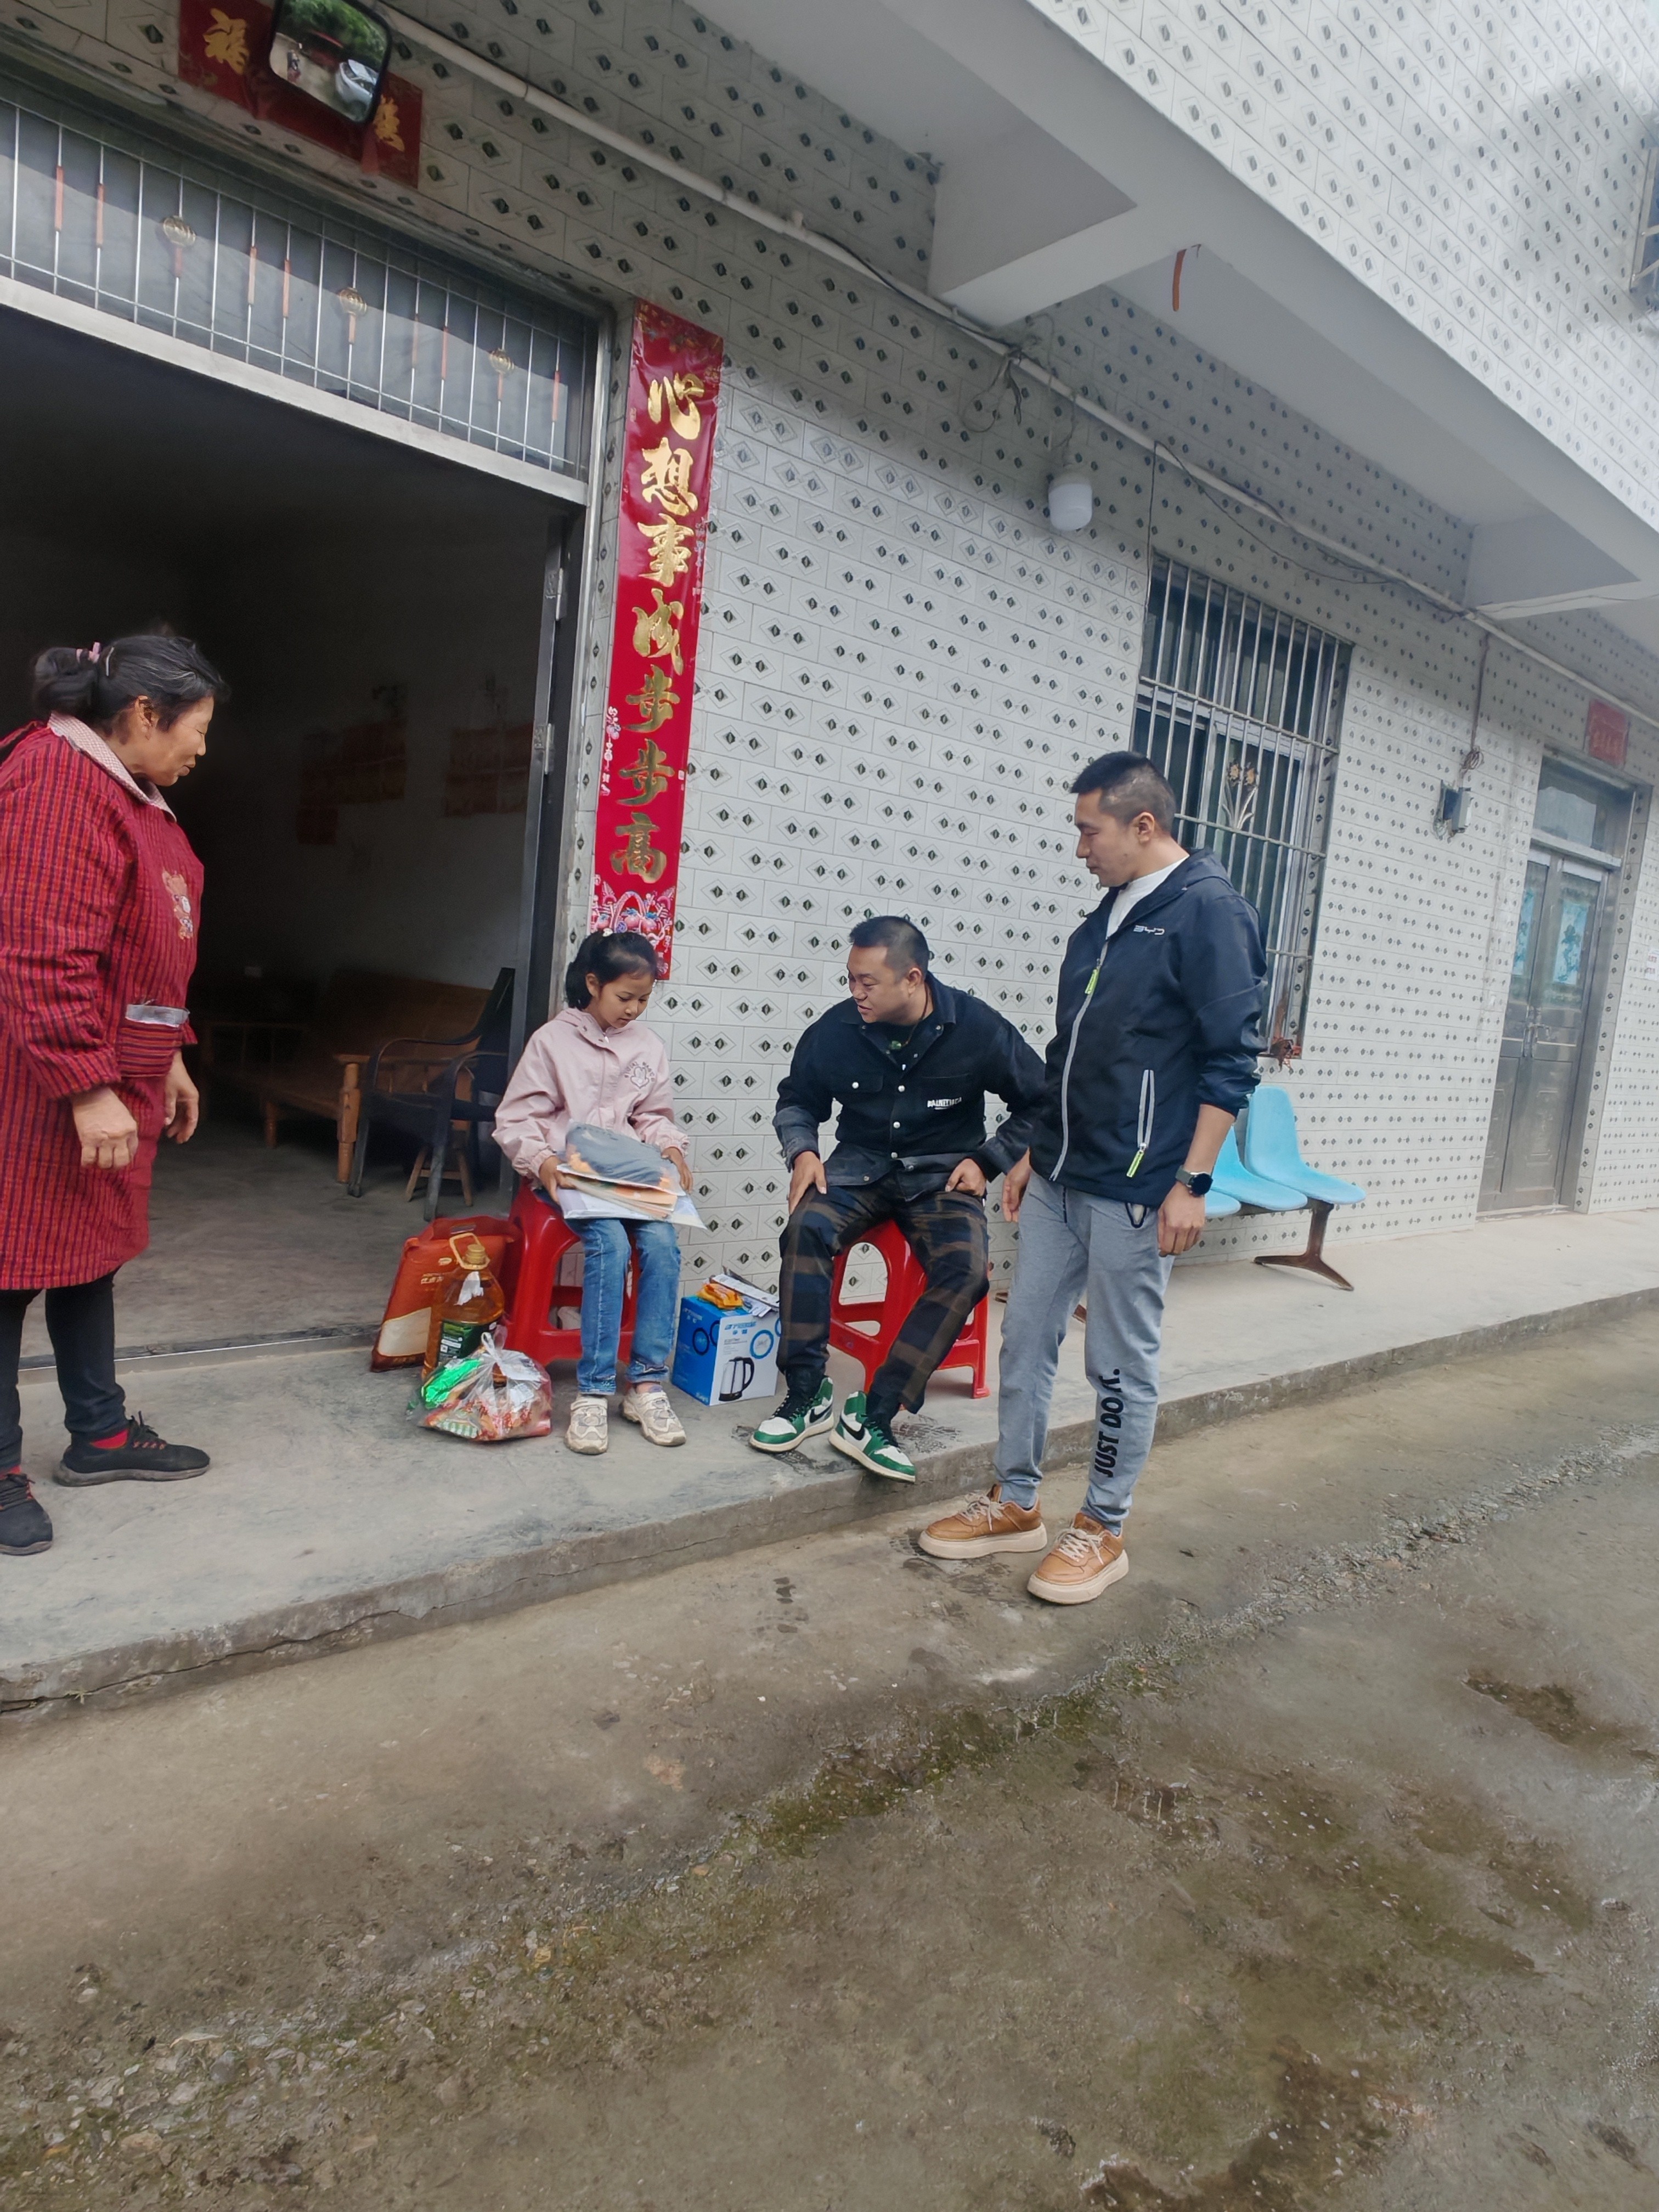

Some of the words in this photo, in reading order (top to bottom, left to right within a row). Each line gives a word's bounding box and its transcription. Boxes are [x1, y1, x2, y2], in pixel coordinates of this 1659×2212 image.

[610, 372, 705, 884] 心想事成步步高
[1133, 924, 1165, 935] BYD
[1100, 1397, 1124, 1429] DO
[1094, 1431, 1119, 1478] JUST
